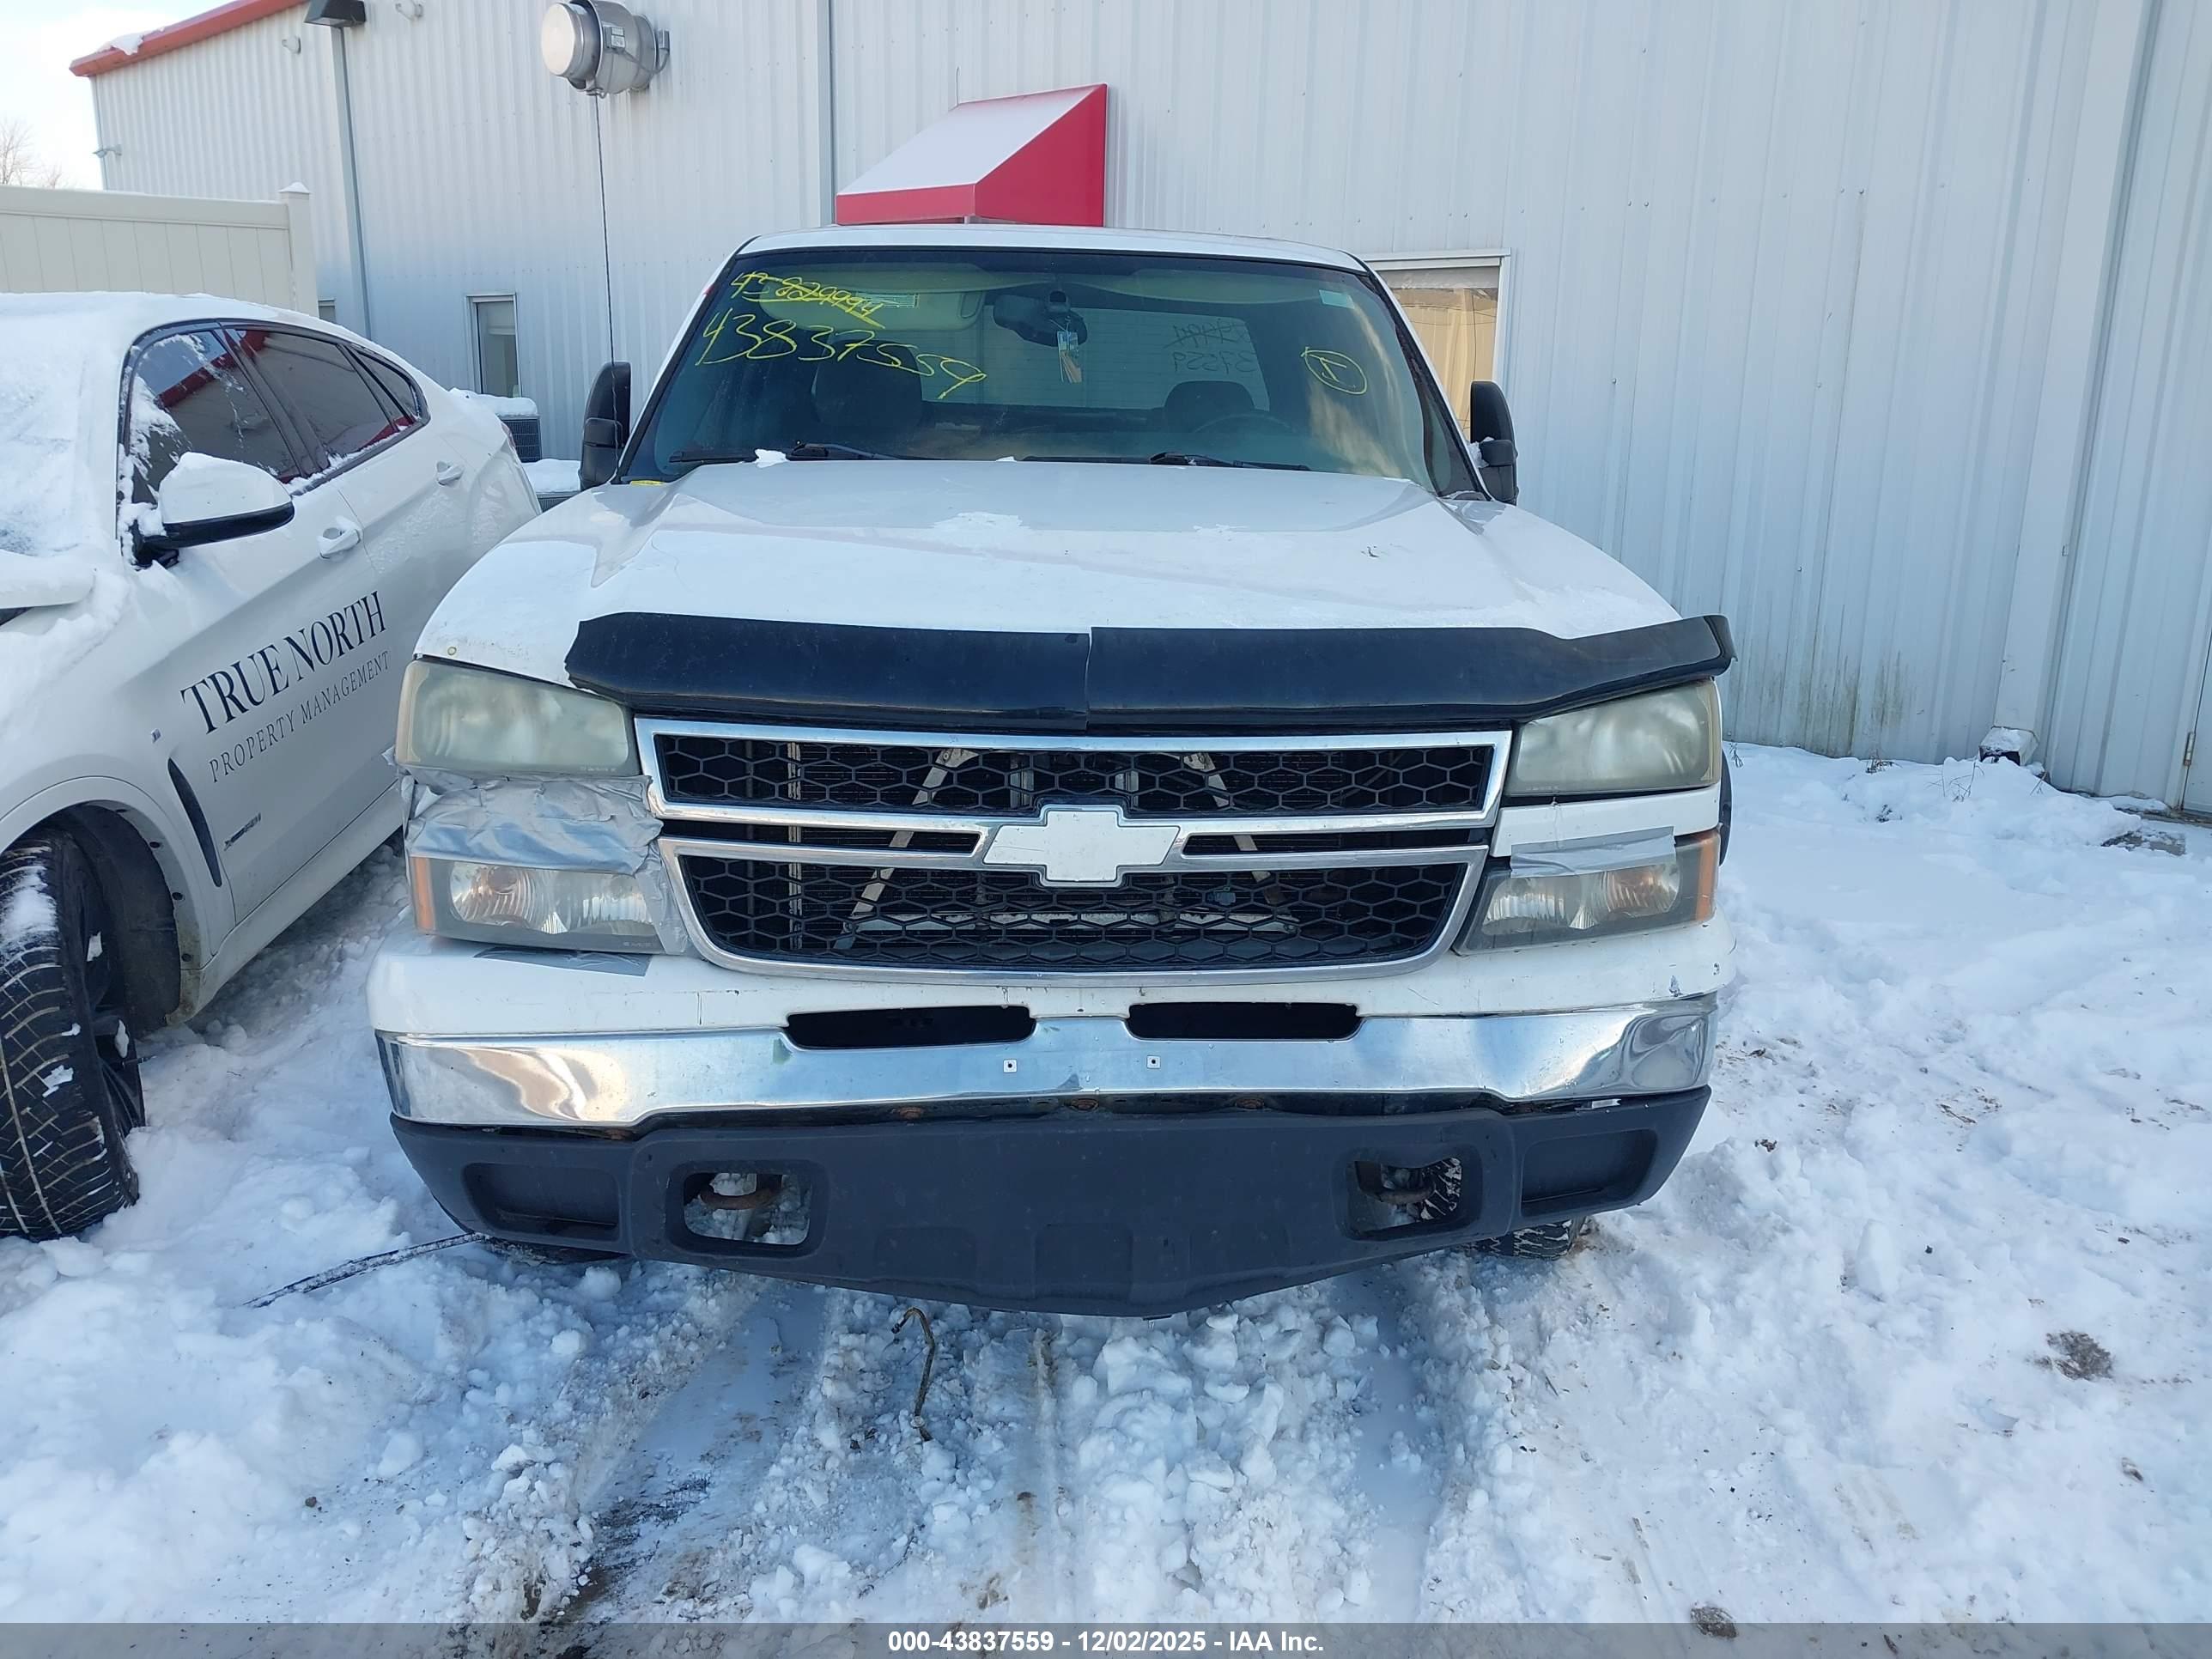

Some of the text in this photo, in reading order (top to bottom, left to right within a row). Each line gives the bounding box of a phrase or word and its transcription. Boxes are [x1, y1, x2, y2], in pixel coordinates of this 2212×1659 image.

[696, 307, 988, 399] 43837559
[180, 591, 386, 734] TRUE NORTH
[210, 650, 389, 783] PROPERTY MANAGEMENT
